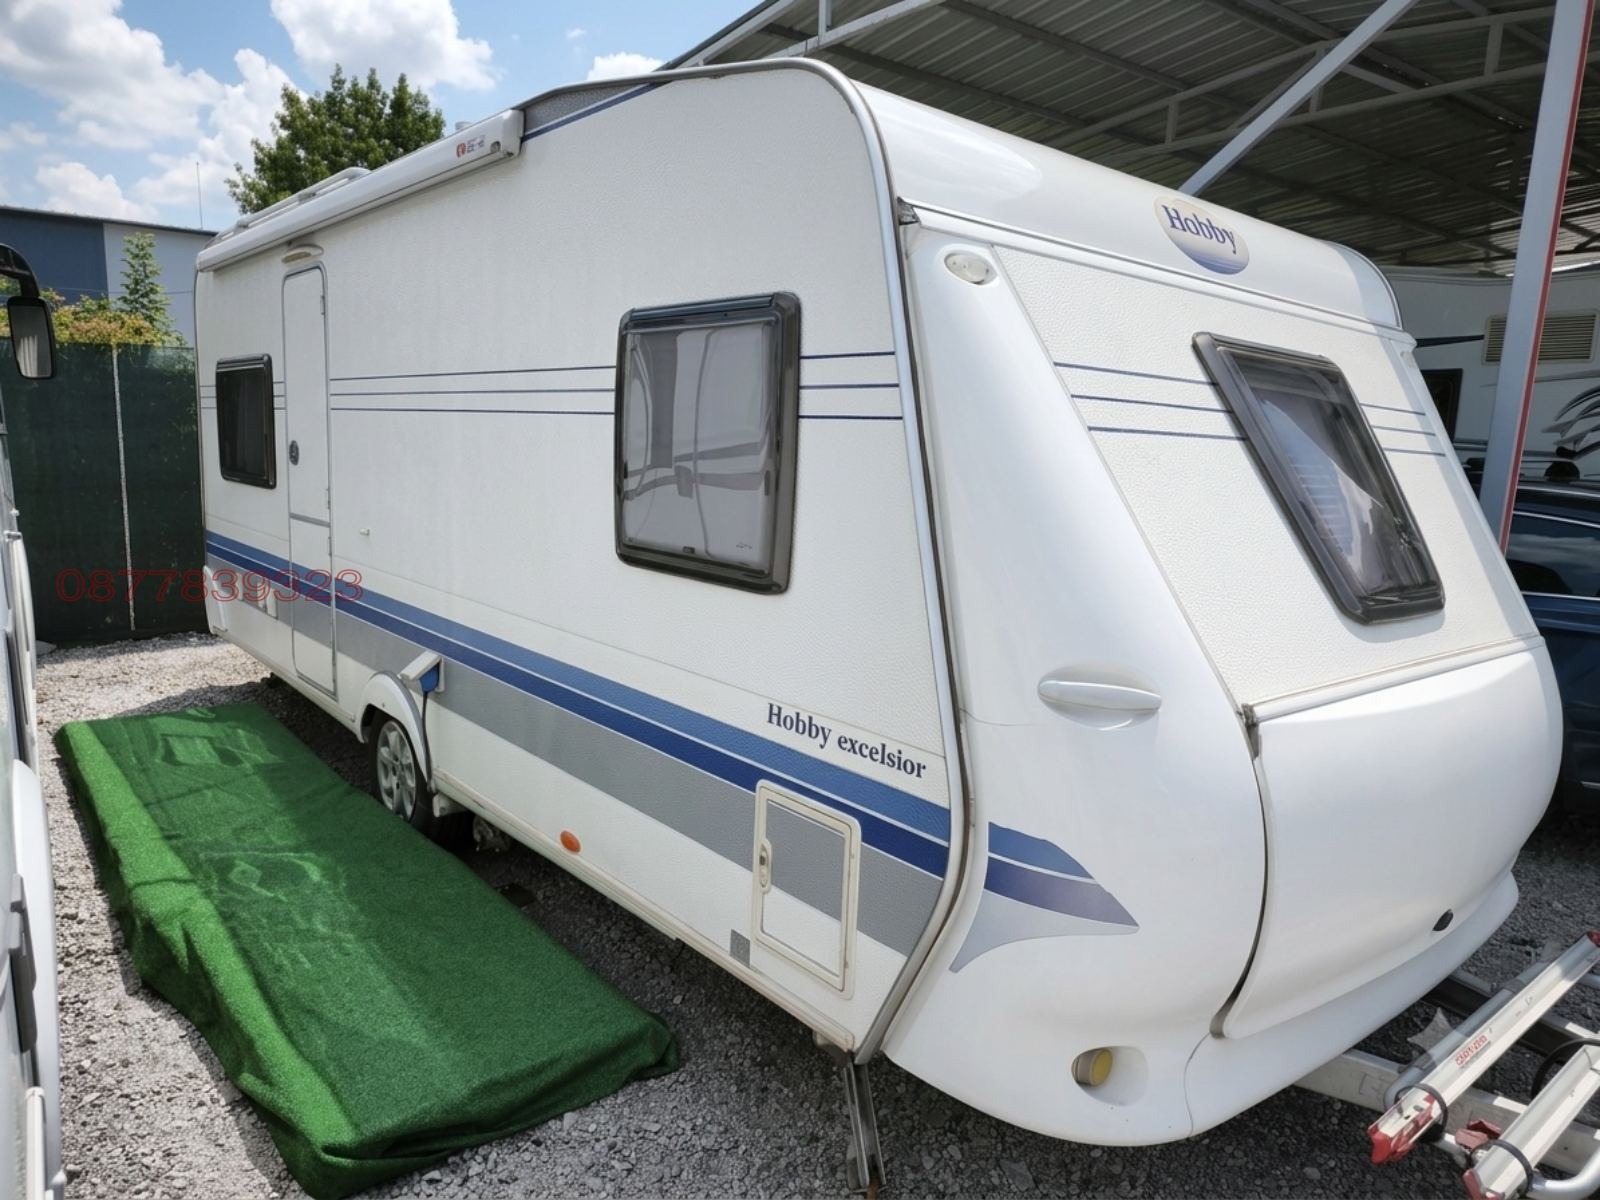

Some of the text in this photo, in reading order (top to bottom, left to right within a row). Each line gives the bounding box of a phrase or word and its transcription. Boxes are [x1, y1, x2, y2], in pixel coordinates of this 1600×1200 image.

[1161, 204, 1237, 255] Hobby
[767, 702, 926, 778] Hobby excelsior
